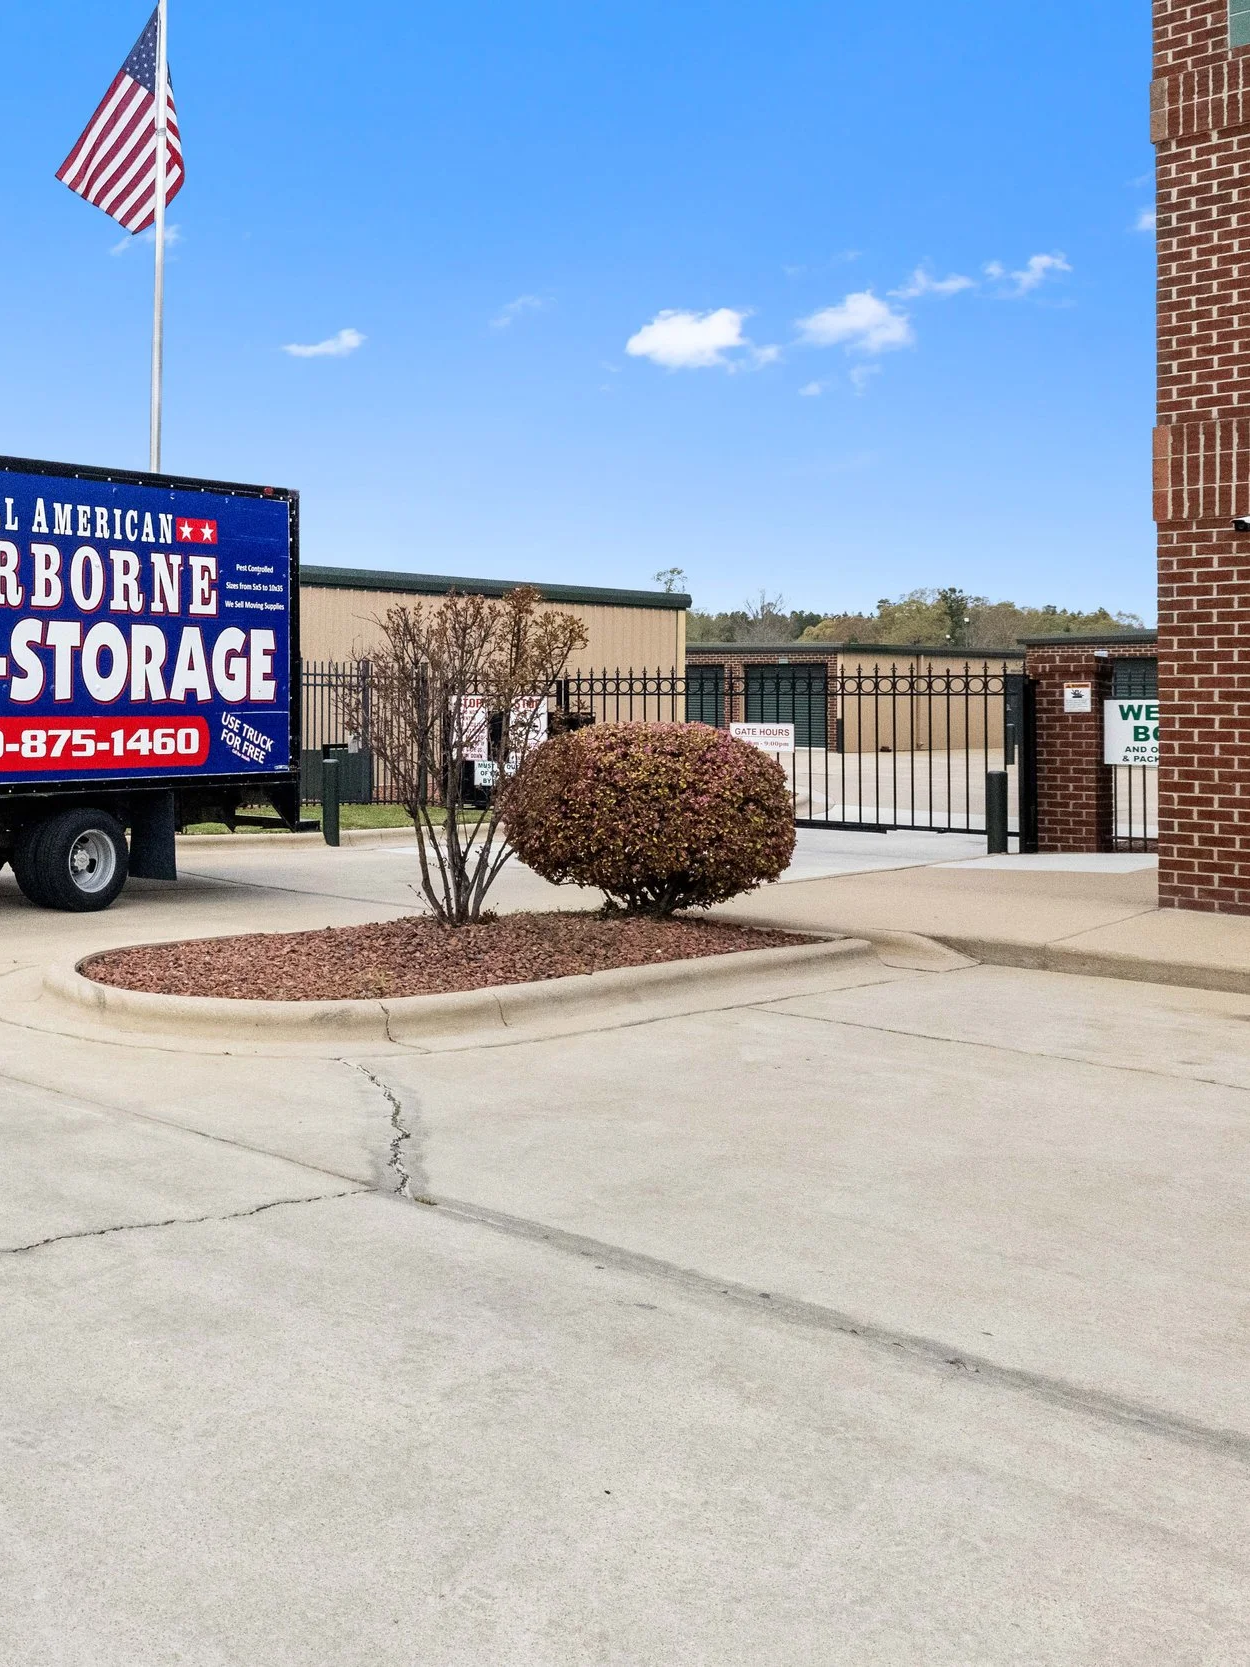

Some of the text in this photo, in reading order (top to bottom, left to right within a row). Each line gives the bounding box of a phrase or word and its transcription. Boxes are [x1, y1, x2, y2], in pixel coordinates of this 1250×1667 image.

[31, 497, 174, 544] AMERICAN
[236, 563, 274, 573] Pest Controlled
[226, 581, 239, 590] Sizes
[239, 582, 252, 590] from
[252, 583, 262, 591] 5x5
[225, 600, 234, 608] We
[244, 601, 263, 611] Moving
[264, 602, 285, 611] Supplies
[457, 698, 483, 708] TOP
[221, 711, 274, 752] USE TRUCK
[734, 727, 790, 737] GATE HOURS
[220, 728, 241, 750] FOR
[242, 741, 266, 764] FREE
